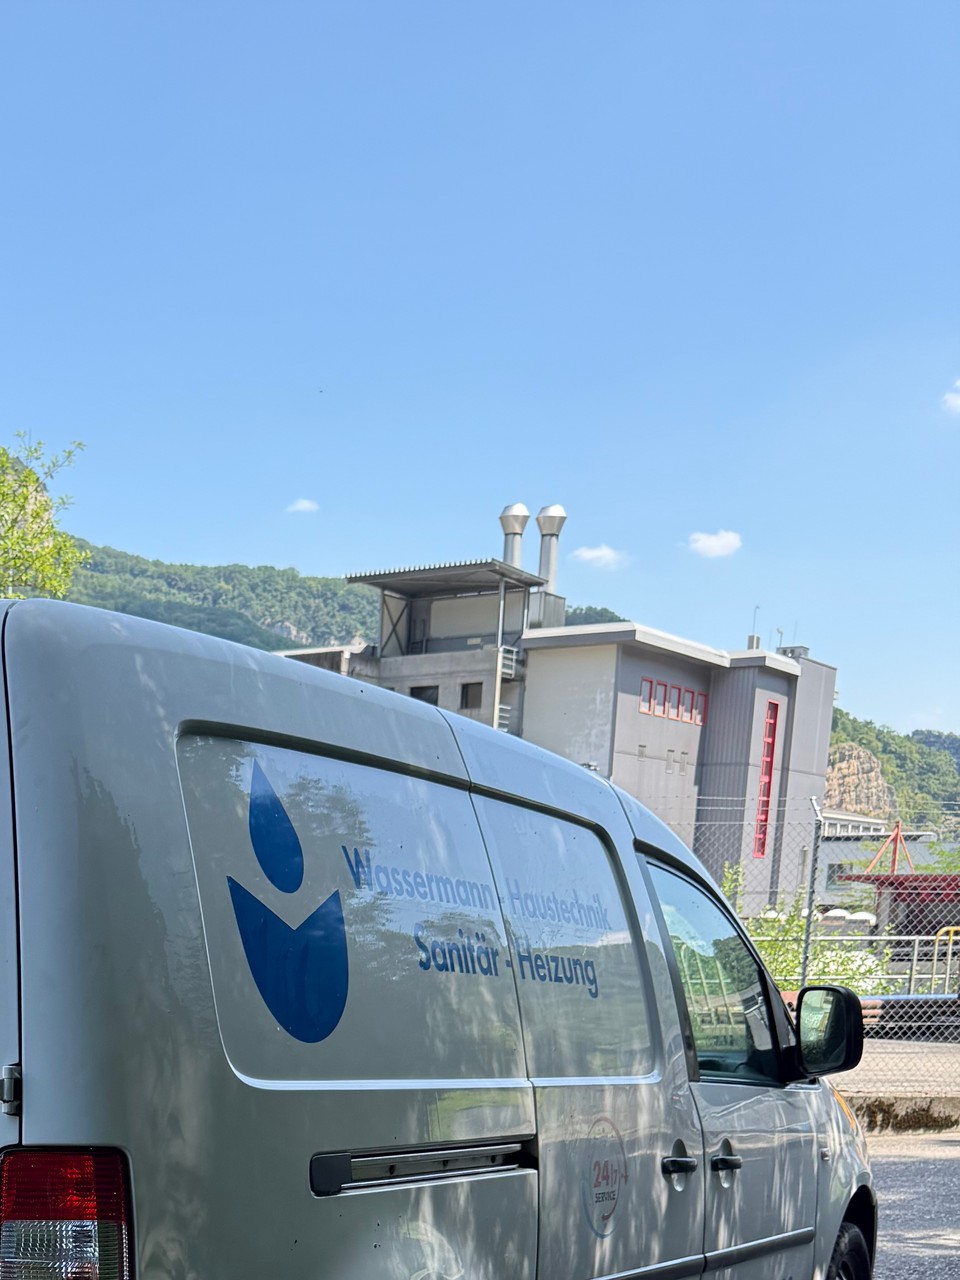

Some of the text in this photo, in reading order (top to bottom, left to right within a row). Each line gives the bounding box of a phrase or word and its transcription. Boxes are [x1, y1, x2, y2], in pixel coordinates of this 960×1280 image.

[342, 845, 496, 911] Wassermann
[505, 877, 613, 931] Haustechnik
[413, 922, 499, 977] Sanitär
[514, 928, 598, 999] Heizung
[595, 1190, 616, 1203] SERVICE
